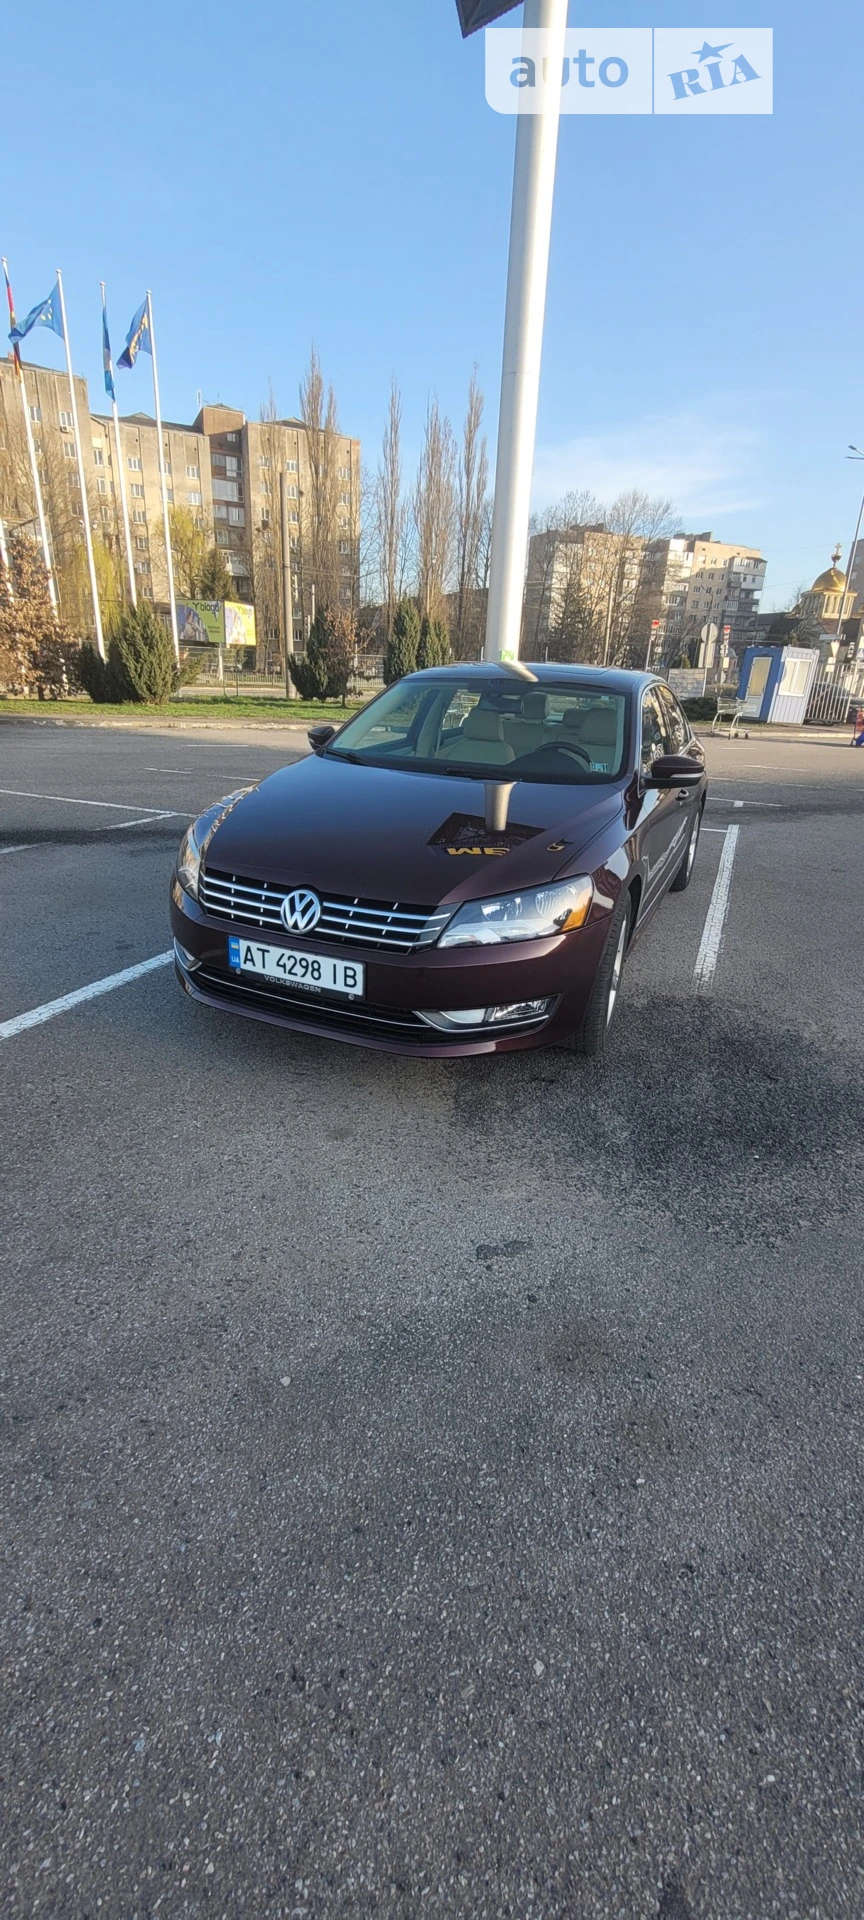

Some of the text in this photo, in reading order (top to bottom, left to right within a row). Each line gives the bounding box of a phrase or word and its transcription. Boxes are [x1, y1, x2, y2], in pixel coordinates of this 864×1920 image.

[231, 955, 240, 964] UA
[243, 945, 358, 989] AT 4298 IB
[263, 974, 322, 993] VOLKSWAGEN
